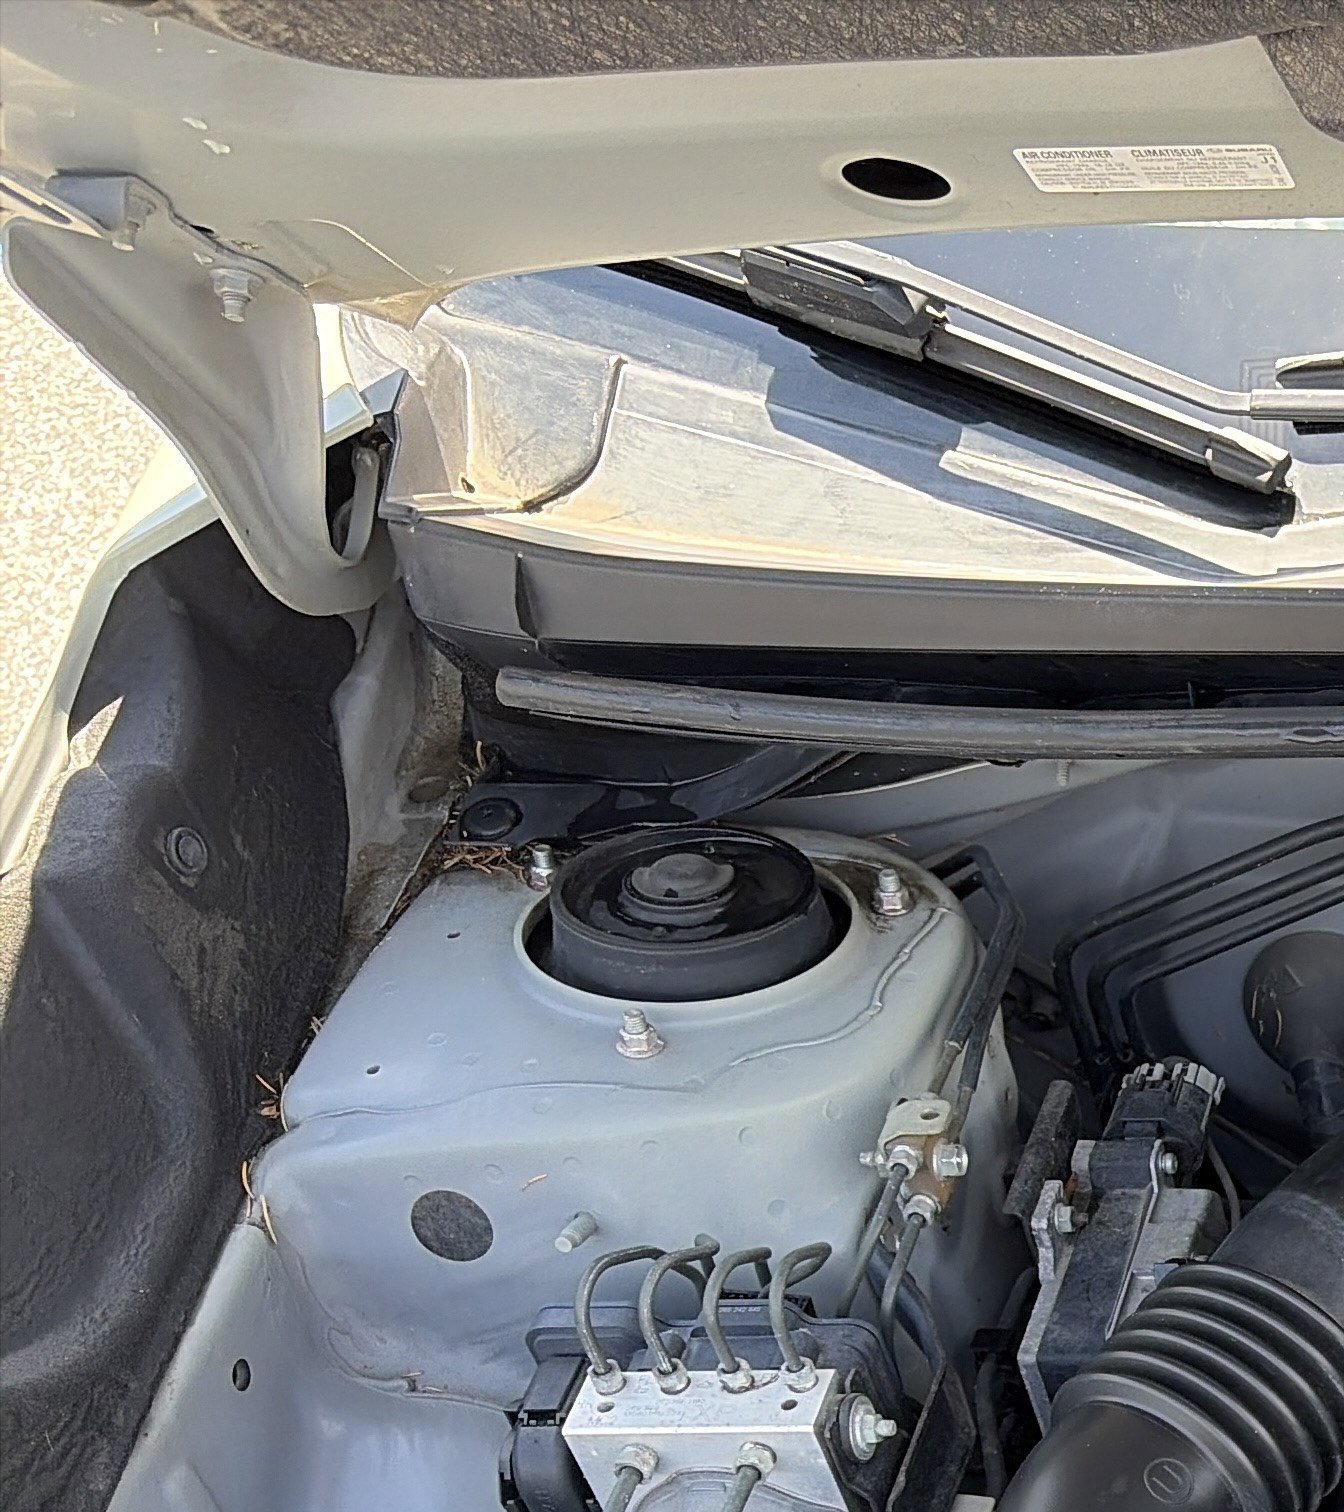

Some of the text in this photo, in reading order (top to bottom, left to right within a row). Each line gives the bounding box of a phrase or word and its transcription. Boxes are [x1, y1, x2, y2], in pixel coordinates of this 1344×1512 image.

[1021, 150, 1113, 159] AIR CONDITIONER
[1131, 148, 1205, 158] CLIMATISEUR
